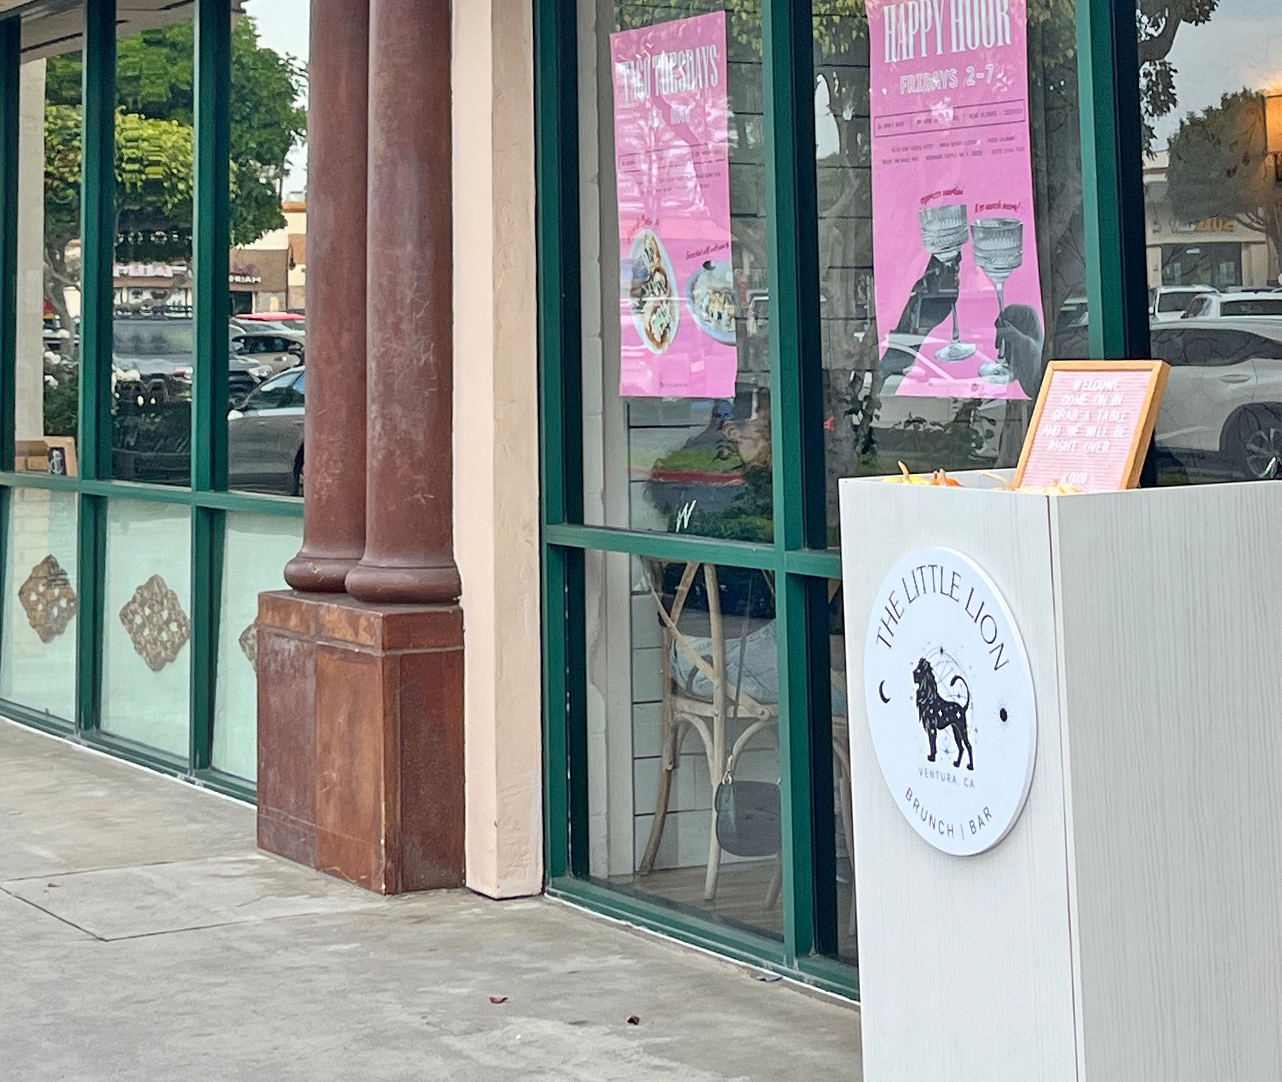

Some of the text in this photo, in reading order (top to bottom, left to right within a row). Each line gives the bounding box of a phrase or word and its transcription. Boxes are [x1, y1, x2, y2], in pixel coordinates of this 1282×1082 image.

[652, 45, 719, 96] TUESDAYS
[900, 64, 995, 94] FRIDAYS 2-7
[1073, 378, 1120, 392] WELCOME
[1061, 394, 1124, 407] COME ON IN
[1052, 409, 1128, 423] GRAB A TABLE
[1041, 425, 1126, 438] AND WE WILL BE
[1048, 440, 1111, 453] RIGHT OVER
[1060, 472, 1088, 485] XOXO
[876, 564, 1010, 672] THE LITTLE LION
[964, 777, 975, 789] CA
[905, 787, 954, 838] BRUNCH
[969, 806, 992, 835] BAR
